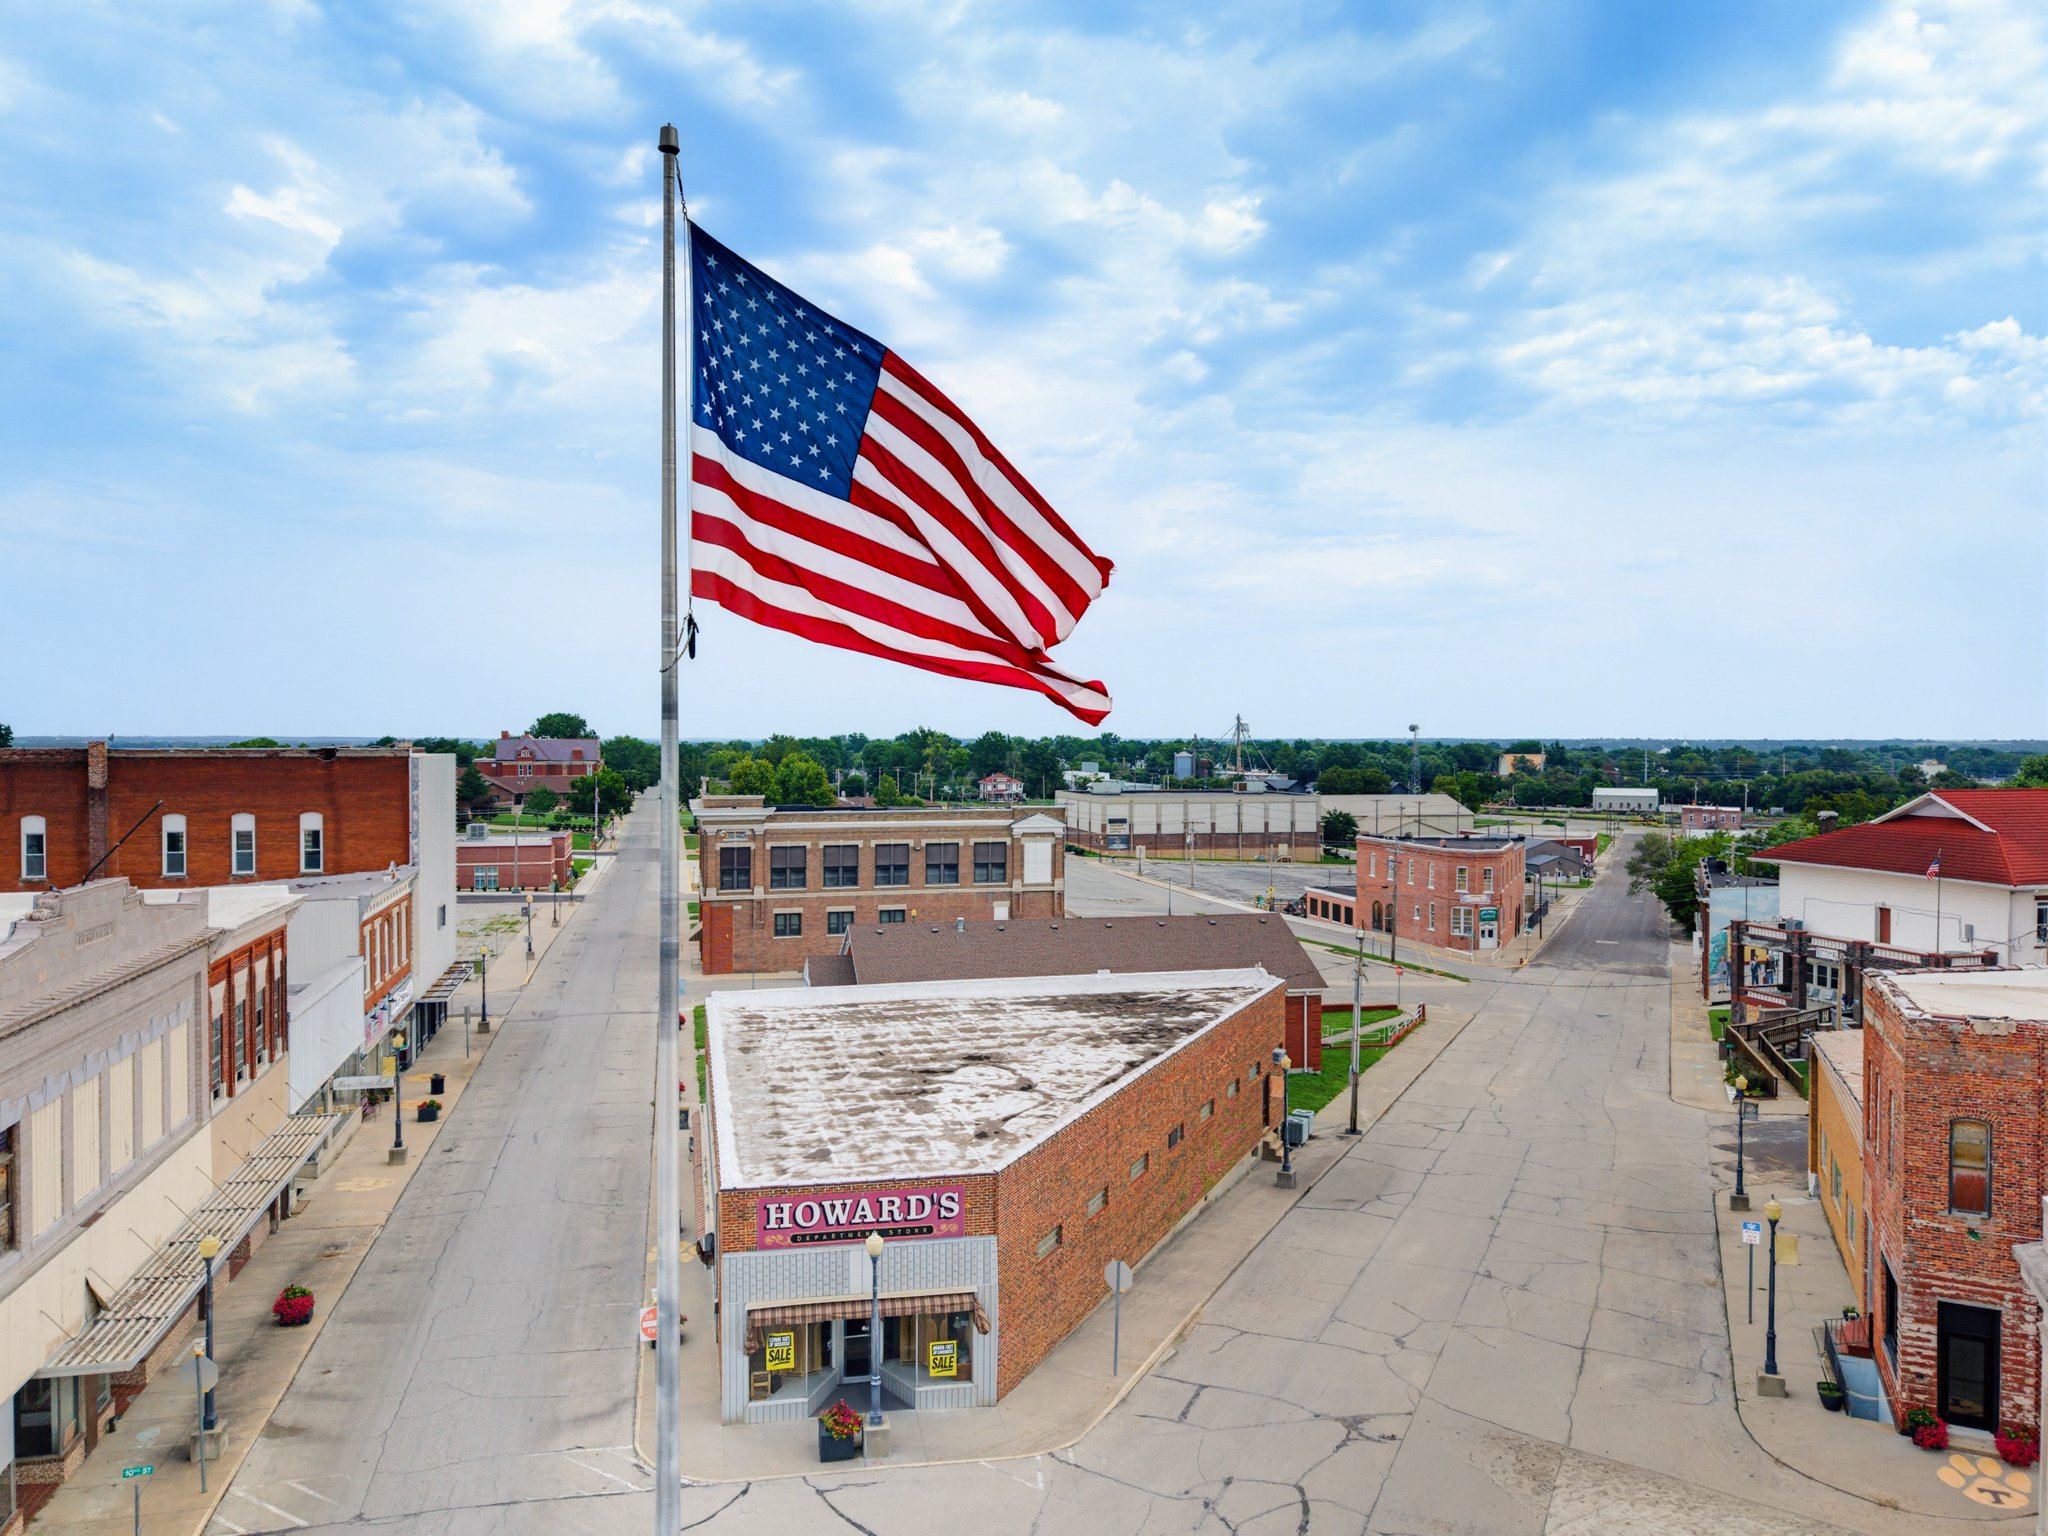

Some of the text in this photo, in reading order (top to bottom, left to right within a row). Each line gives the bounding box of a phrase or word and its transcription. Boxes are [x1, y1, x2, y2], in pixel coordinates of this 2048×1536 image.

[765, 1192, 960, 1230] HOWARD'S
[796, 1227, 928, 1242] DEPARTMEN STORE
[768, 1348, 791, 1363] SALE
[932, 1356, 954, 1370] SALE
[1976, 1487, 2012, 1505] T
